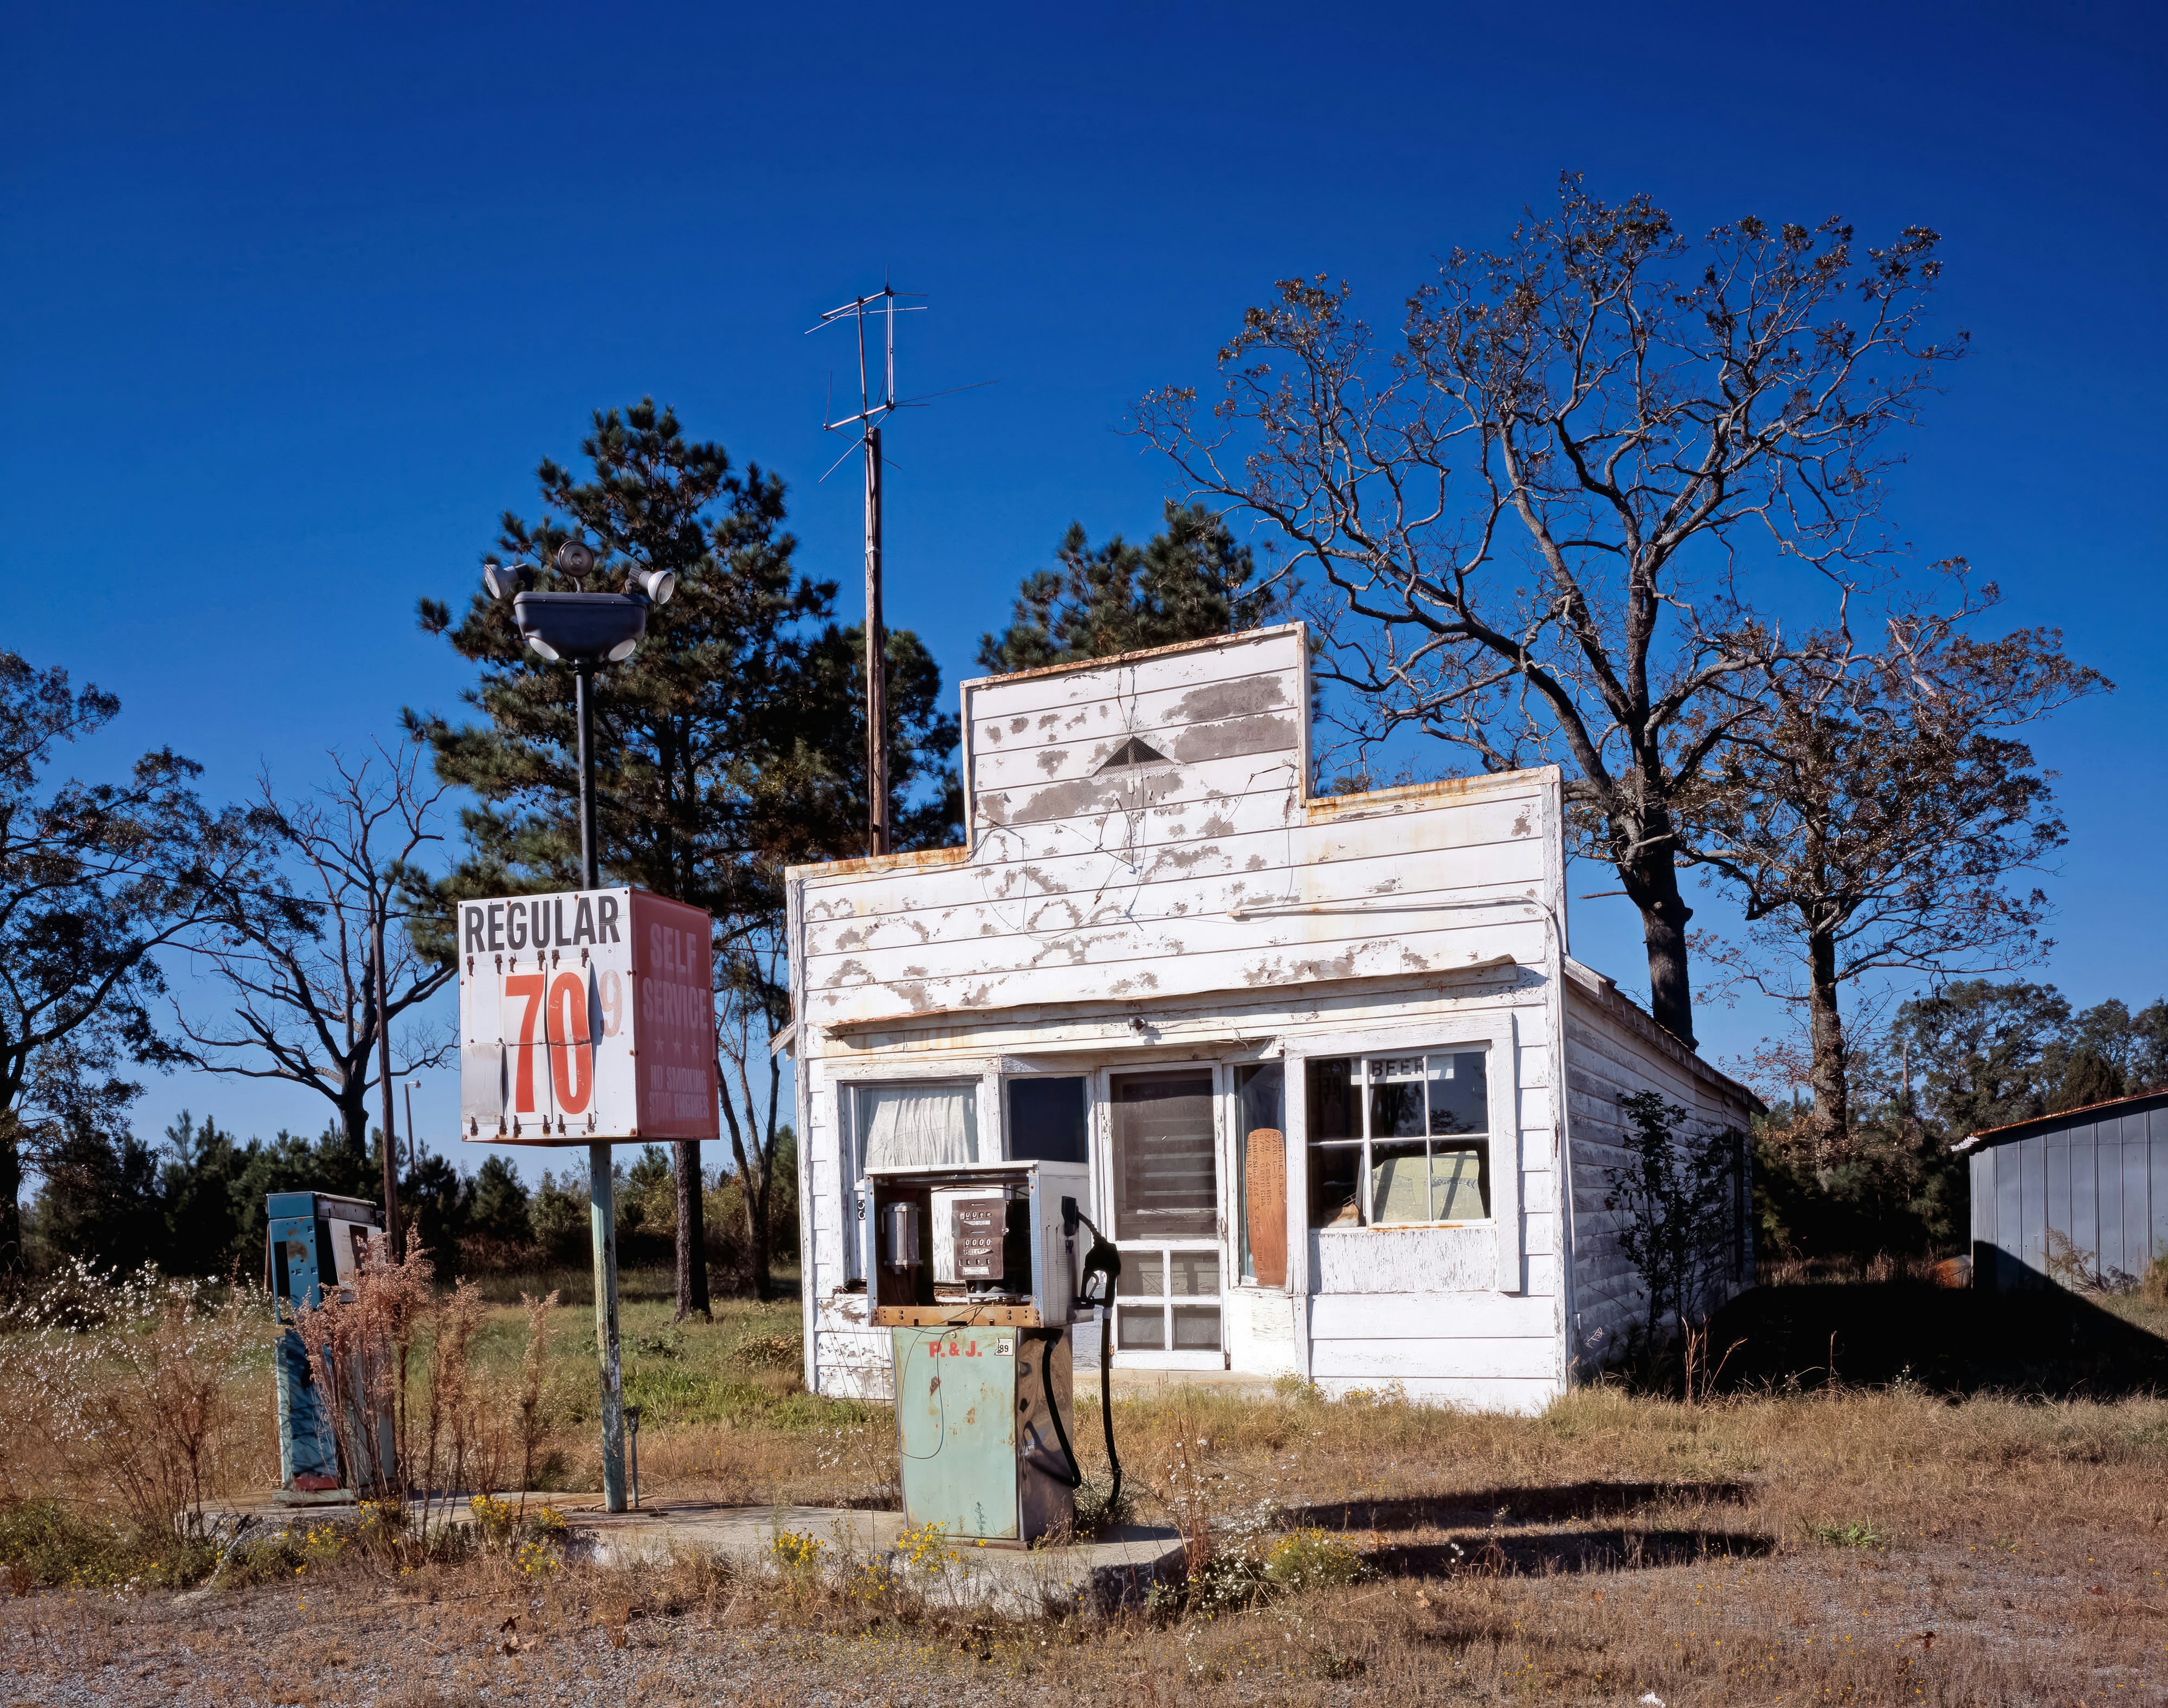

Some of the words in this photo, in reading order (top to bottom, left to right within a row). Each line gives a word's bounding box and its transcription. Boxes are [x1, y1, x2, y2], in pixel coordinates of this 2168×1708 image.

[465, 896, 621, 953] REGULAR
[650, 923, 696, 974] SELF
[643, 977, 708, 1030] SERVICE
[505, 972, 592, 1114] 70
[650, 1065, 663, 1090] NO
[667, 1066, 707, 1093] SMOKING
[1372, 1059, 1424, 1077] BEER
[649, 1091, 671, 1118] STOP
[674, 1094, 709, 1119] ENGINES
[929, 1342, 945, 1357] P.
[949, 1342, 960, 1356] &
[965, 1341, 982, 1357] J.
